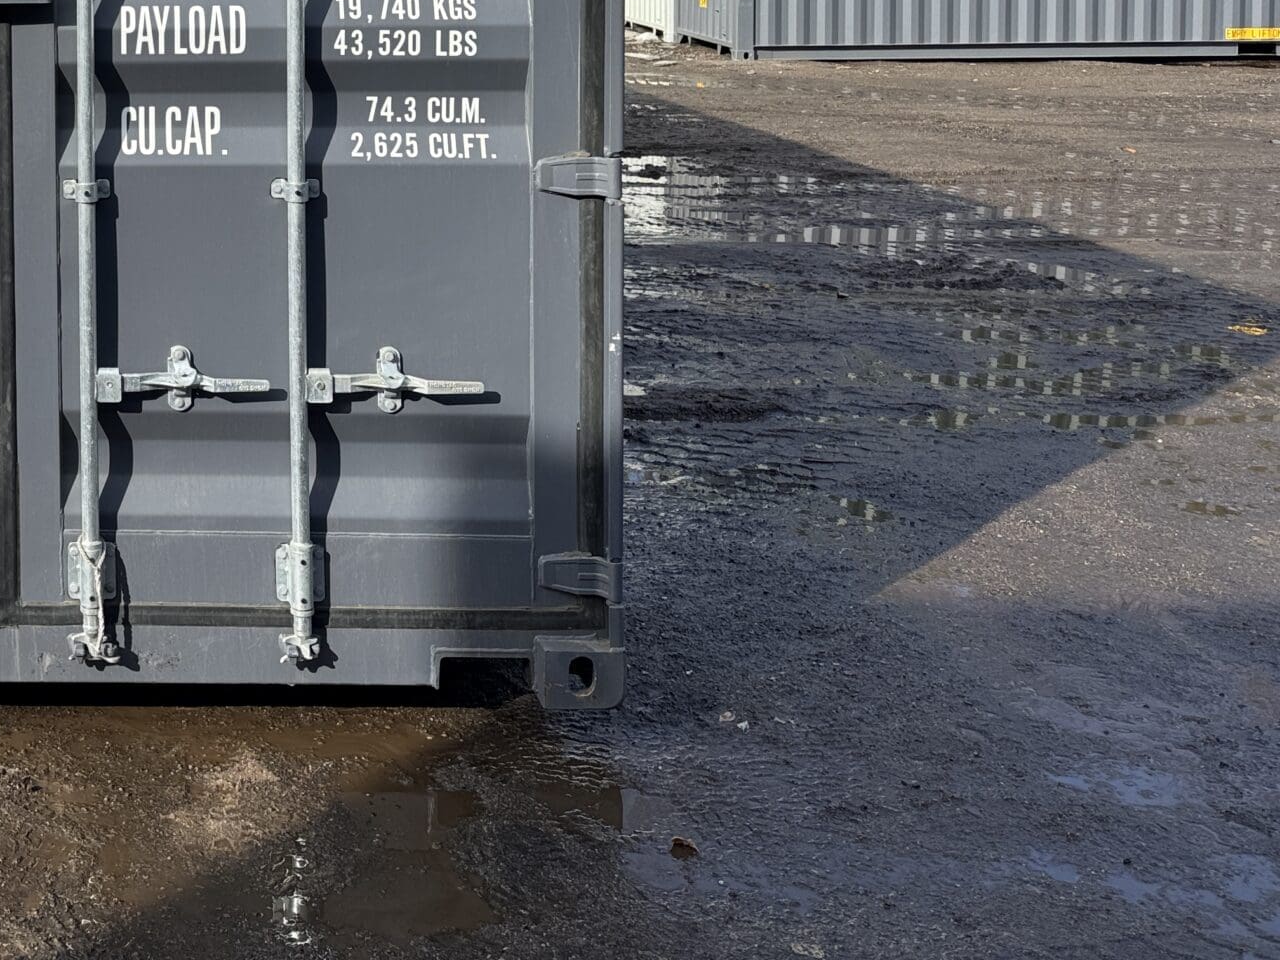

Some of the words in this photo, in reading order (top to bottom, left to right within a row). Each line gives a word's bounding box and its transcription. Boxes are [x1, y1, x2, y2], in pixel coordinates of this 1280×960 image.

[120, 5, 247, 55] PAYLOAD
[334, 29, 421, 60] 43,520
[435, 30, 477, 57] LBS
[121, 106, 228, 155] CU.CAP.
[366, 96, 416, 122] 74.3
[427, 97, 486, 123] CU.M.
[351, 132, 418, 161] 2,625
[429, 133, 497, 159] CU.FT.
